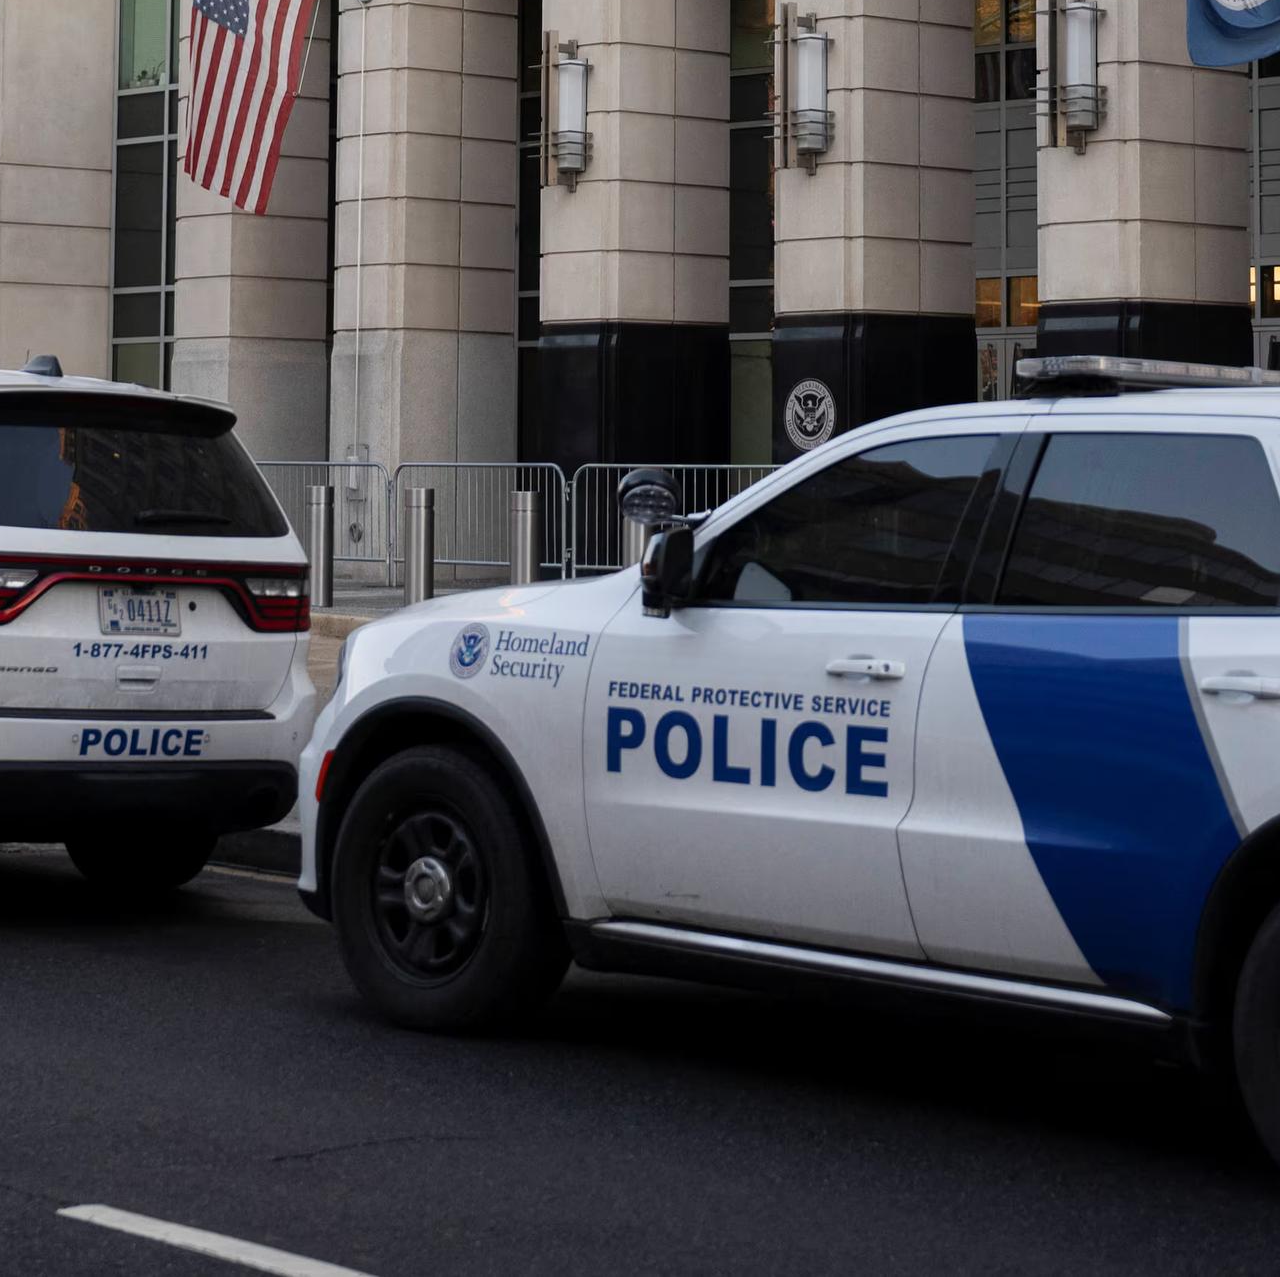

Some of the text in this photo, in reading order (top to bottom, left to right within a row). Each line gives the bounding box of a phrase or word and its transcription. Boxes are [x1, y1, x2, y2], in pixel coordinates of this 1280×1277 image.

[89, 565, 207, 576] DODGE
[73, 643, 208, 660] 1-877-4FPS-411
[495, 630, 590, 657] Homeland
[489, 654, 565, 688] Security
[609, 680, 891, 717] FEDERAL PROTECTIVE SERVICE
[79, 728, 204, 756] POLICE
[606, 706, 889, 797] POLICE
